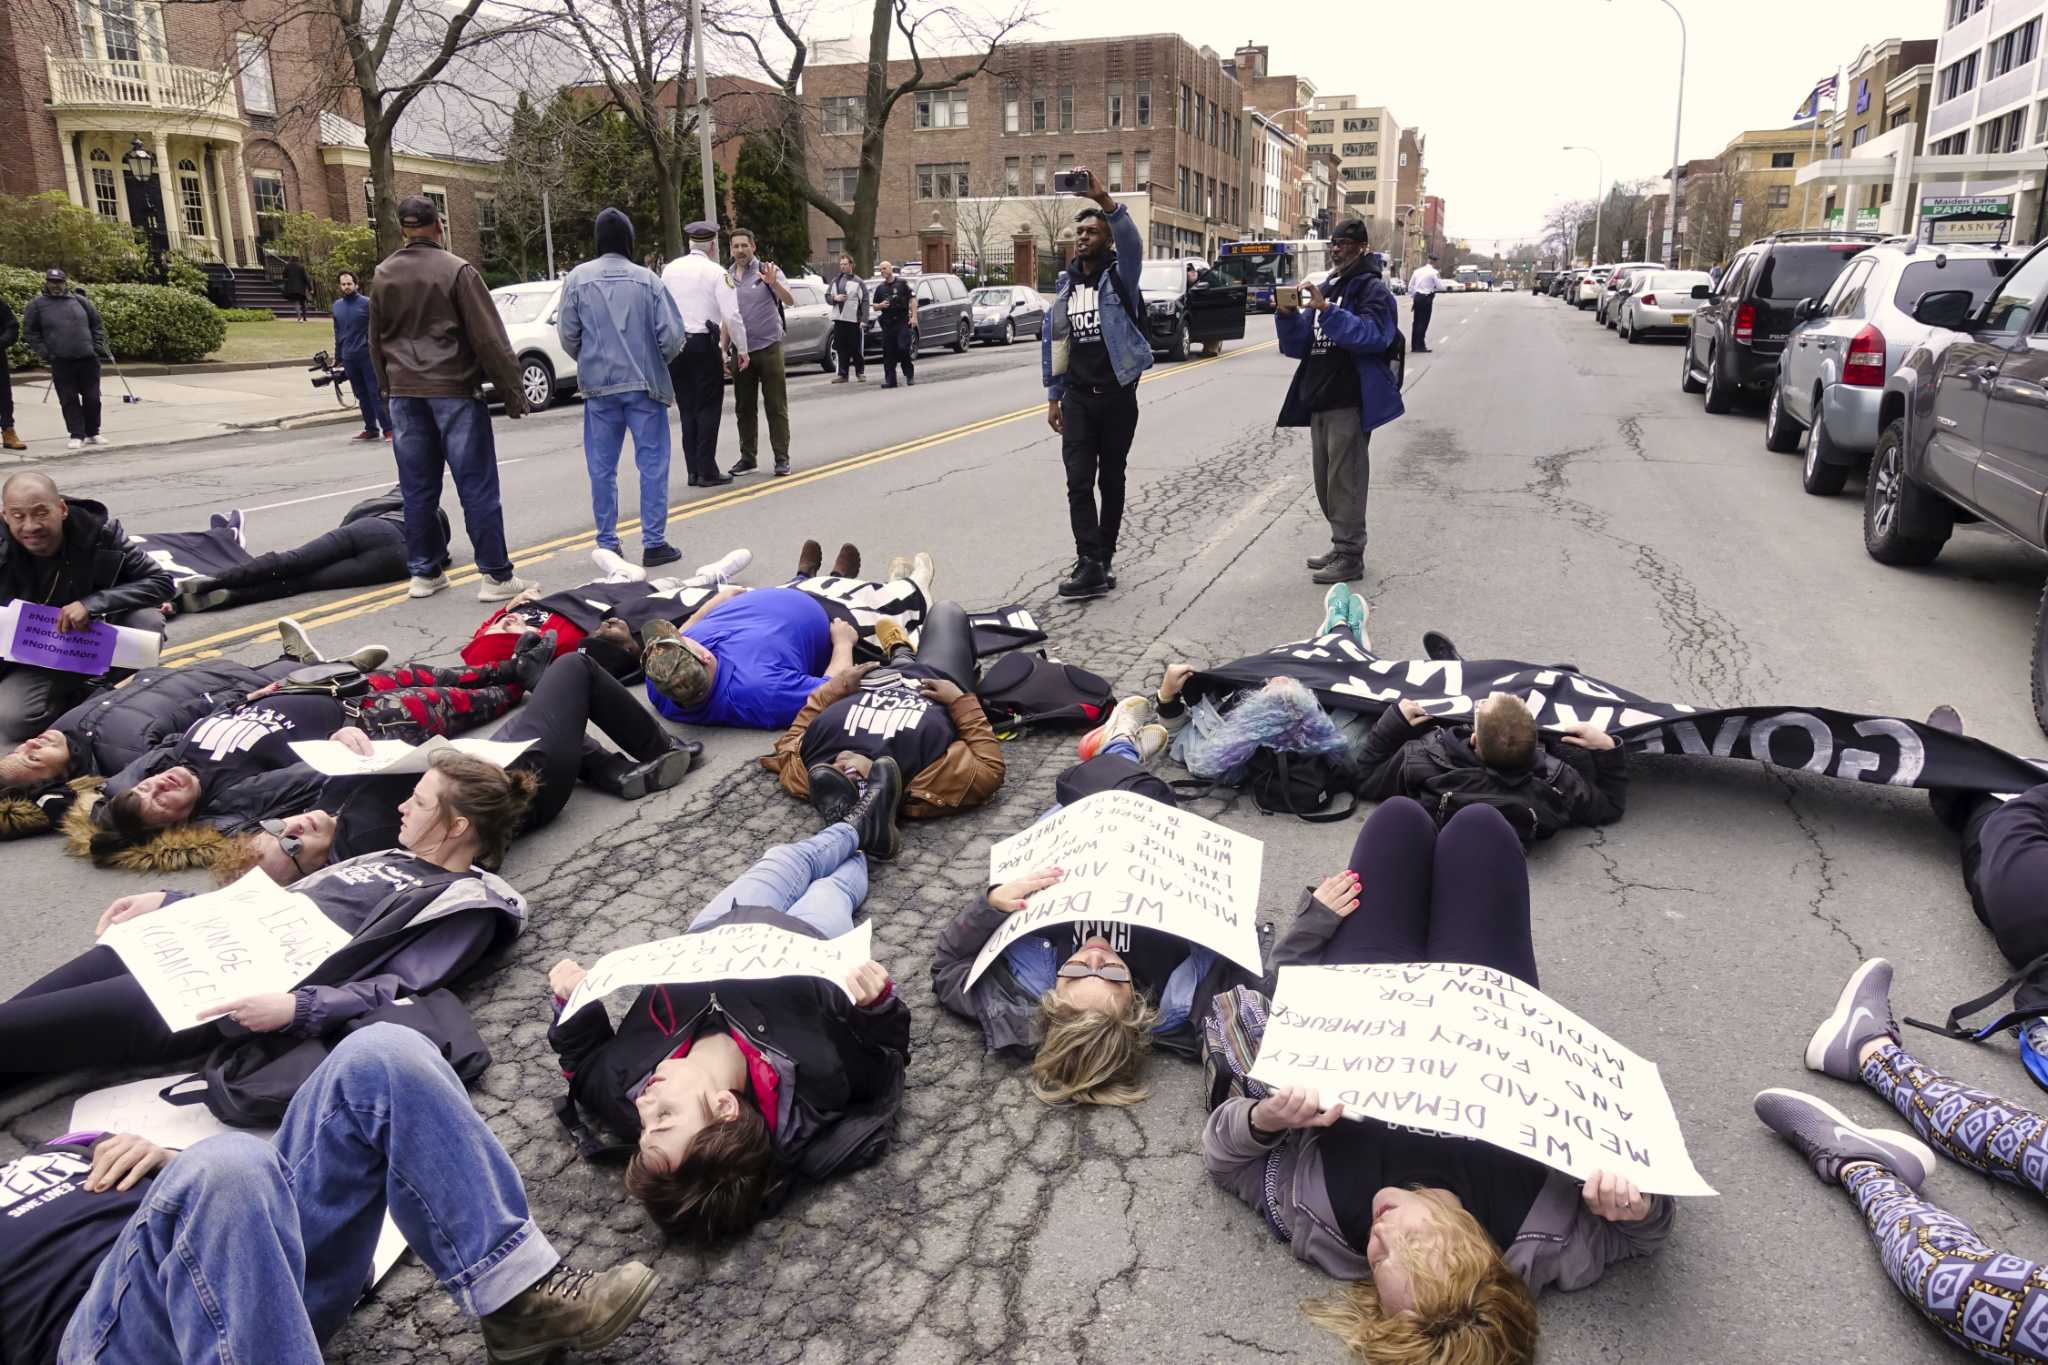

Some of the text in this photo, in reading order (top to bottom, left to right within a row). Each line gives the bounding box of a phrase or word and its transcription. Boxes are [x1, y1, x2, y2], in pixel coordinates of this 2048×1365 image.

[1933, 205, 1998, 214] PARKING
[1950, 223, 1995, 232] FASNY
[22, 639, 98, 659] #NotOneMore
[25, 625, 101, 647] #NotOneMore
[1166, 814, 1182, 829] TO
[1200, 829, 1233, 847] USE
[997, 847, 1034, 873] DRUG
[1195, 841, 1232, 865] WITH
[1126, 864, 1239, 927] MEDICAID
[987, 889, 1164, 953] WE DEMAND
[1378, 986, 1624, 1090] PROVIDERS FOR
[1441, 977, 1626, 1072] MEDICATION
[1429, 1025, 1531, 1075] FAIRLY
[1261, 1048, 1651, 1168] MEDICAID ADEQUATELY
[1337, 1088, 1486, 1130] DEMAND
[1564, 1079, 1634, 1123] AND
[1518, 1125, 1573, 1167] WE
